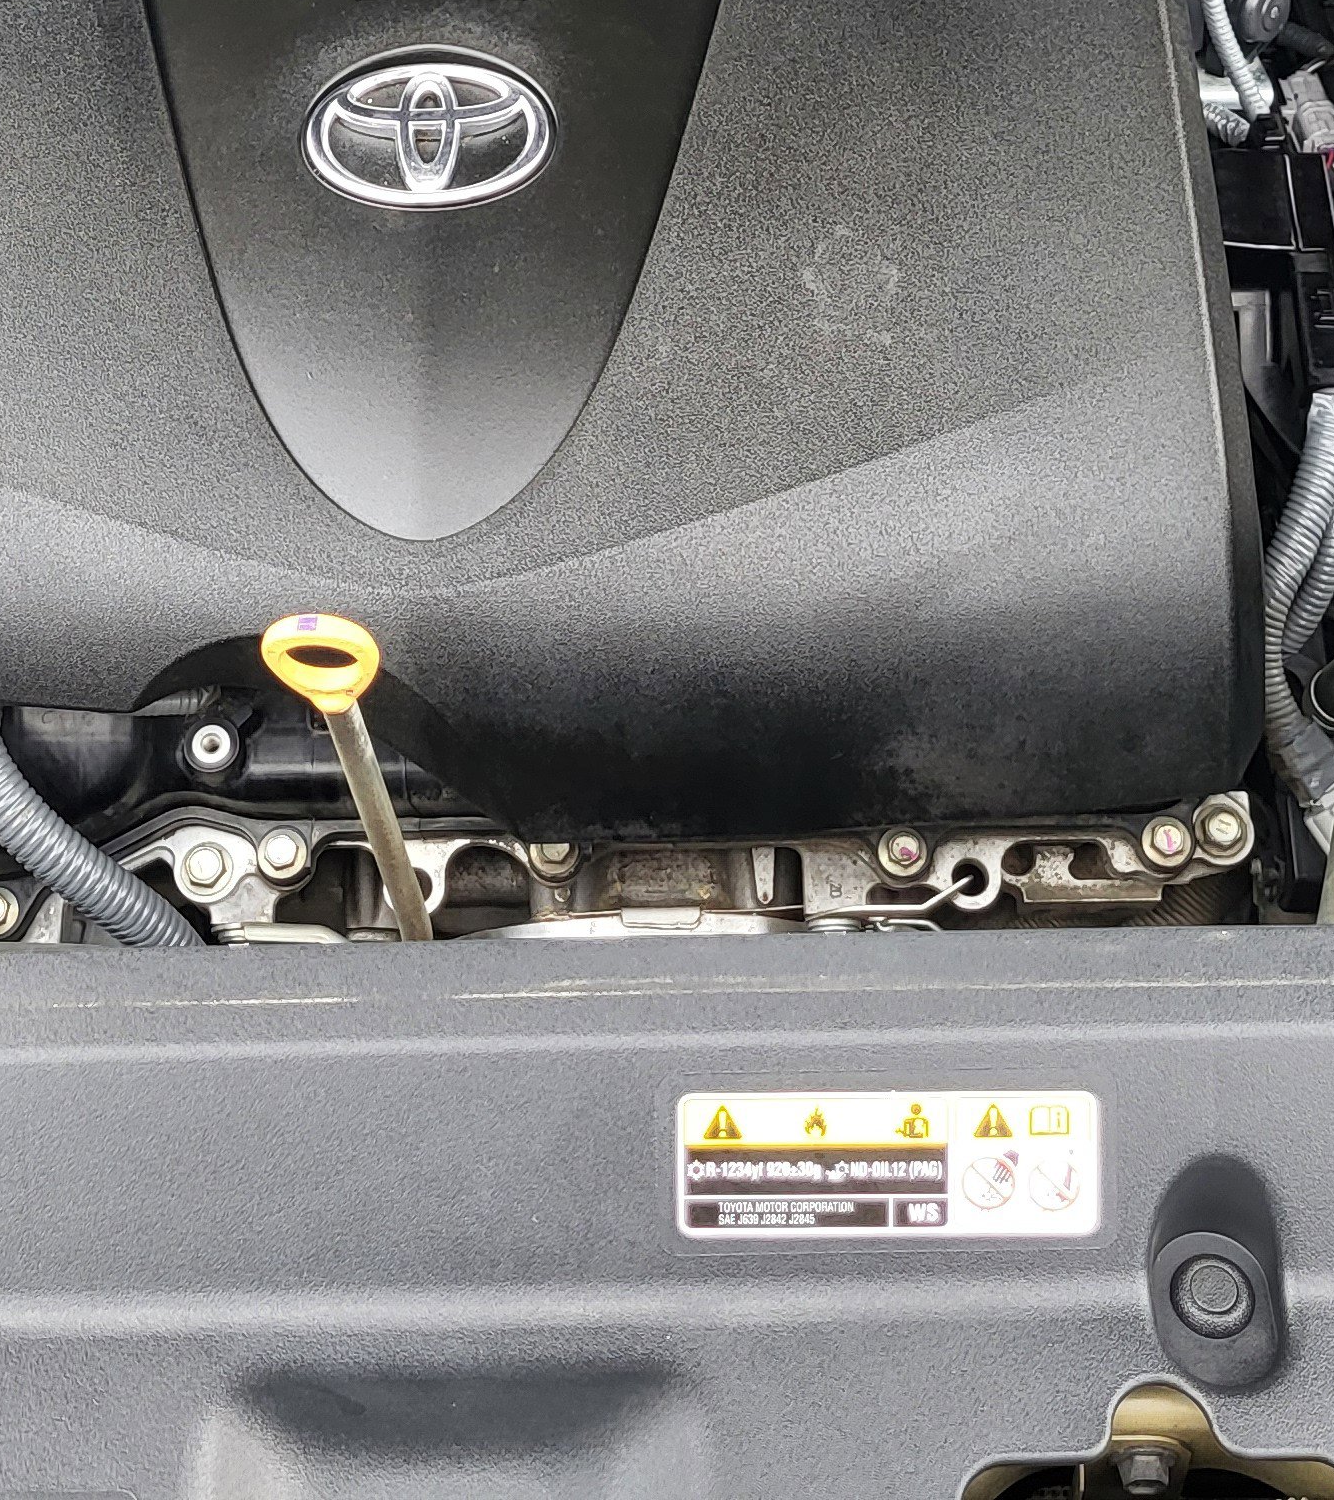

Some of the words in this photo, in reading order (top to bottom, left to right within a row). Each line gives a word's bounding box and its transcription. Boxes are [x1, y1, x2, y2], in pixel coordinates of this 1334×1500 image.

[908, 1160, 943, 1181] (PAG)
[718, 1201, 754, 1213] TOYOTA
[755, 1201, 788, 1213] MOTOR
[790, 1201, 855, 1213] CORPORATION
[906, 1202, 940, 1224] WS
[718, 1213, 736, 1225] SAE
[738, 1213, 759, 1225] J639
[760, 1213, 787, 1225] J2842
[788, 1213, 816, 1225] J2845
